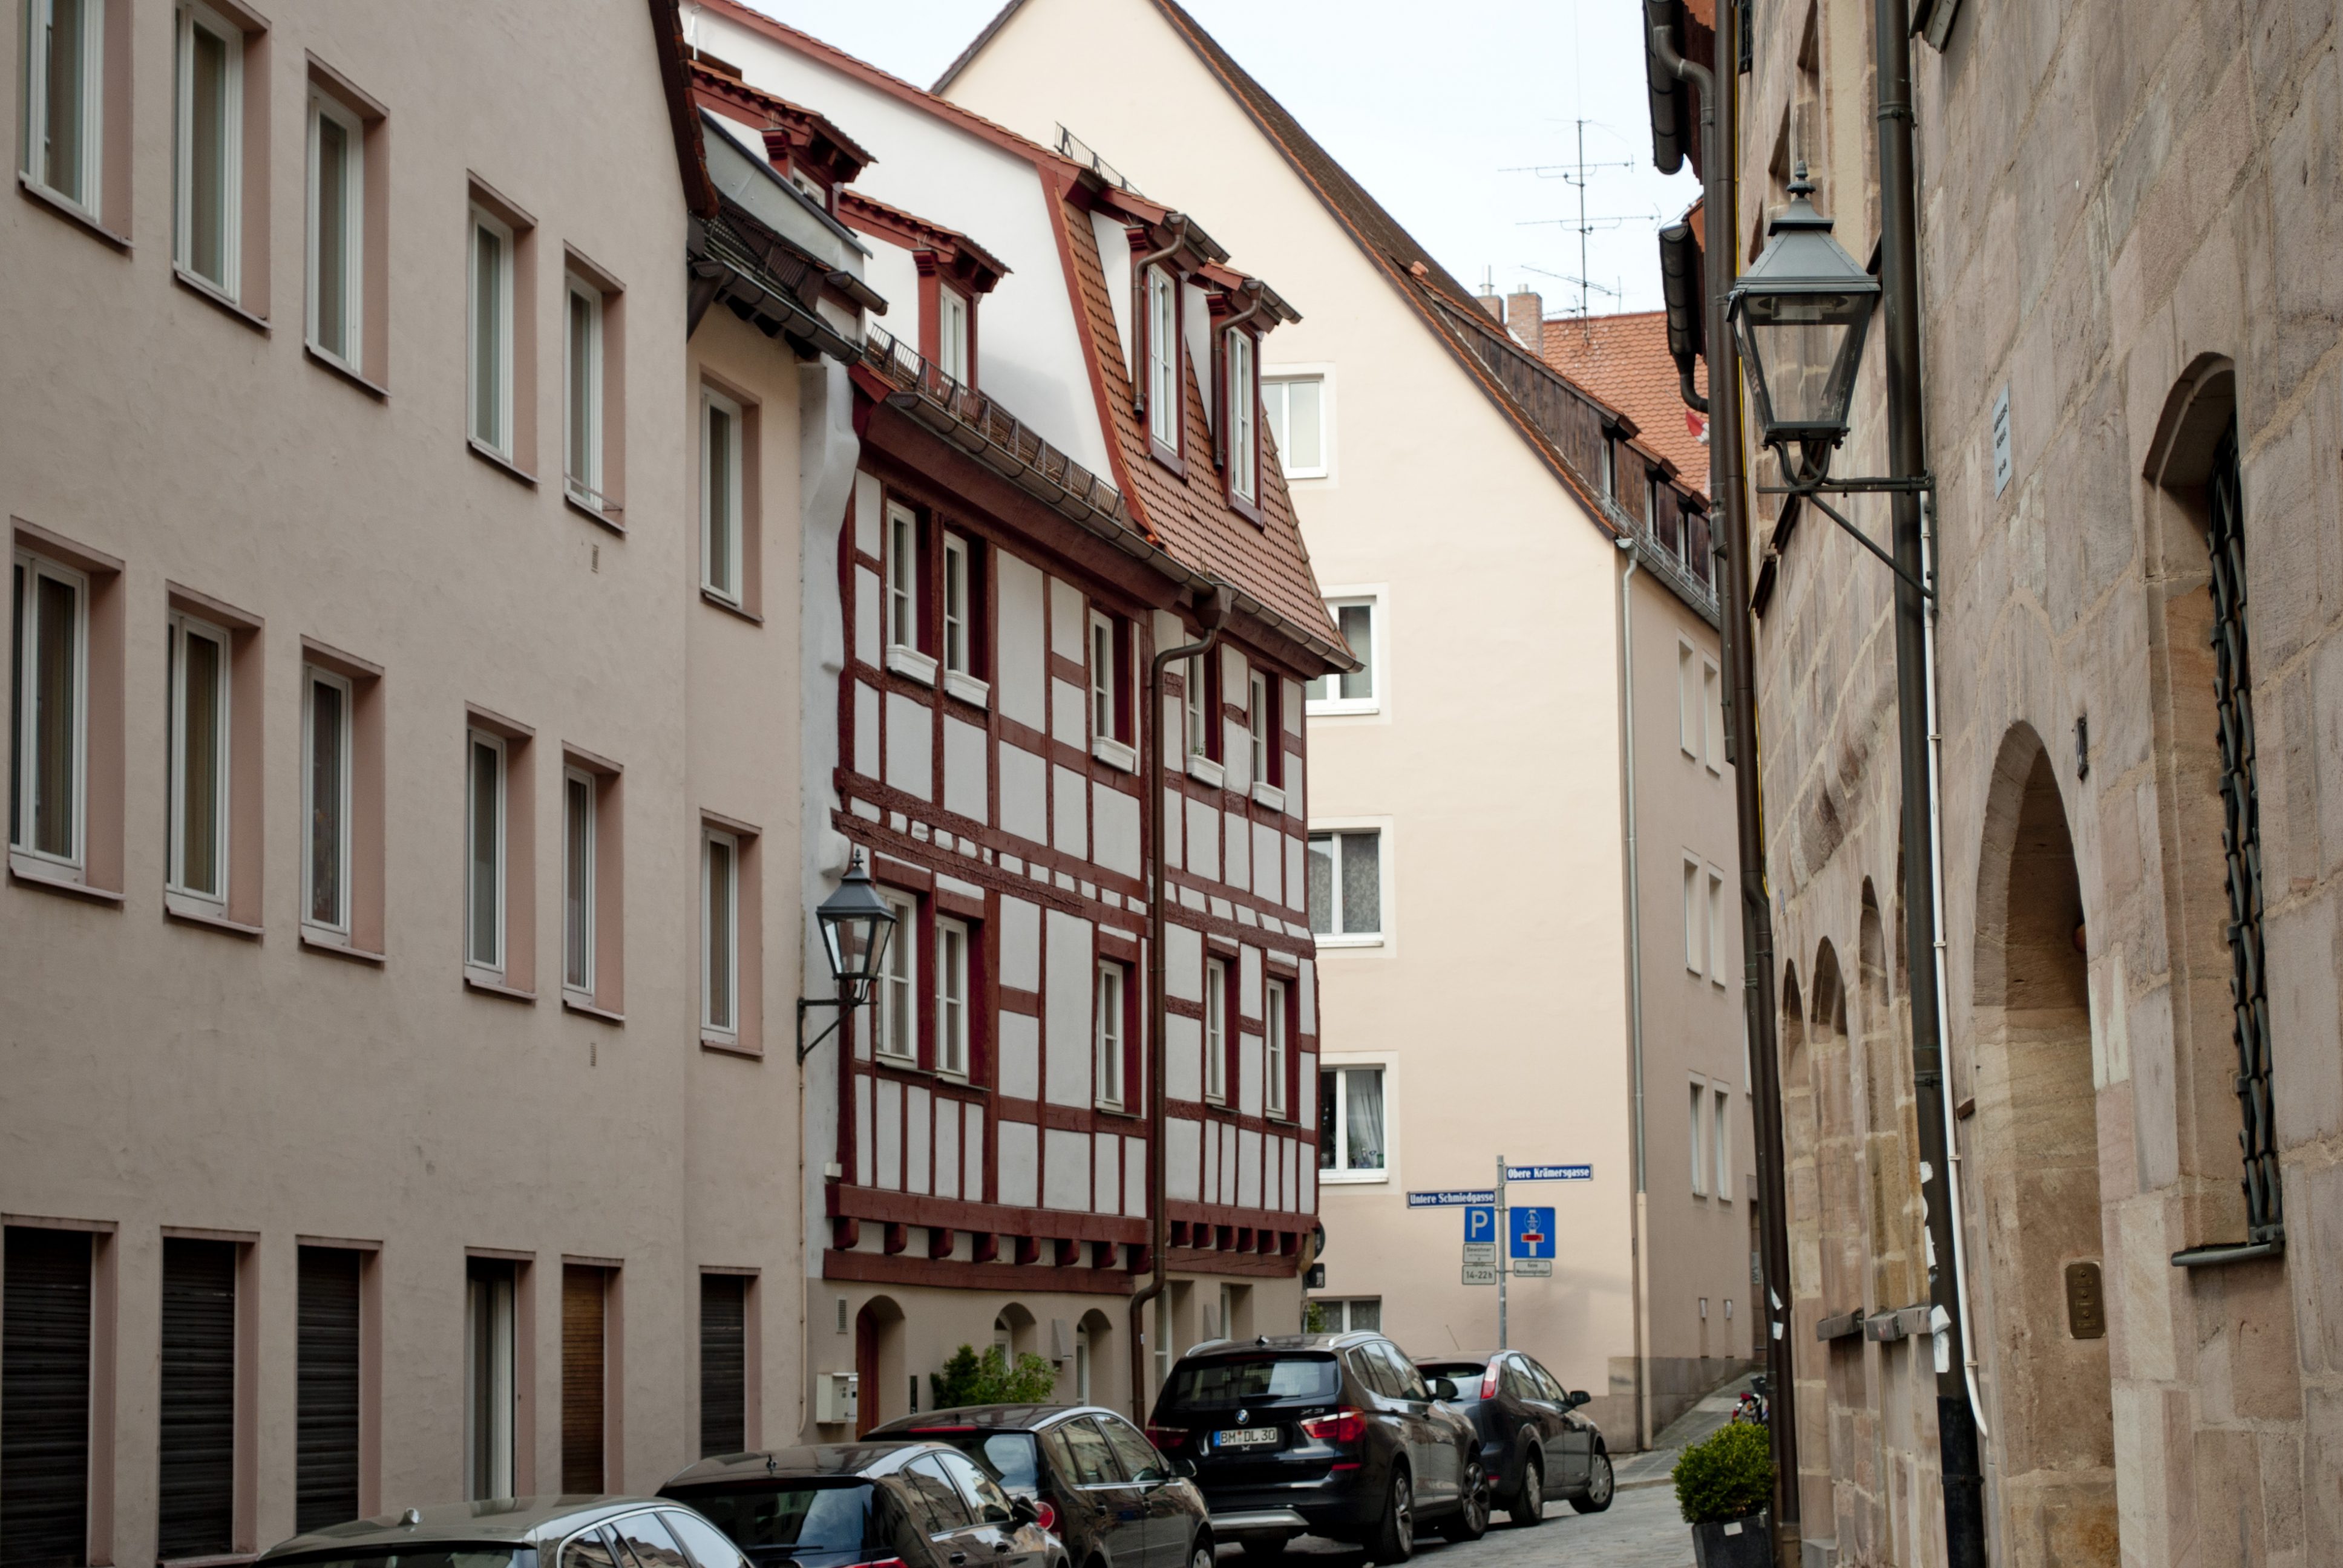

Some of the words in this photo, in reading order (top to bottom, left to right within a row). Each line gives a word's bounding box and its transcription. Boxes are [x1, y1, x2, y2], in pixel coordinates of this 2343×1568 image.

[1508, 1168, 1531, 1178] Obere
[1533, 1167, 1590, 1178] Krämersgasse
[1410, 1194, 1437, 1204] Untere
[1438, 1192, 1494, 1203] Schmiedgasse
[1471, 1210, 1489, 1238] P
[1221, 1432, 1236, 1443] BM
[1244, 1431, 1259, 1442] DL
[1262, 1429, 1276, 1440] 30
